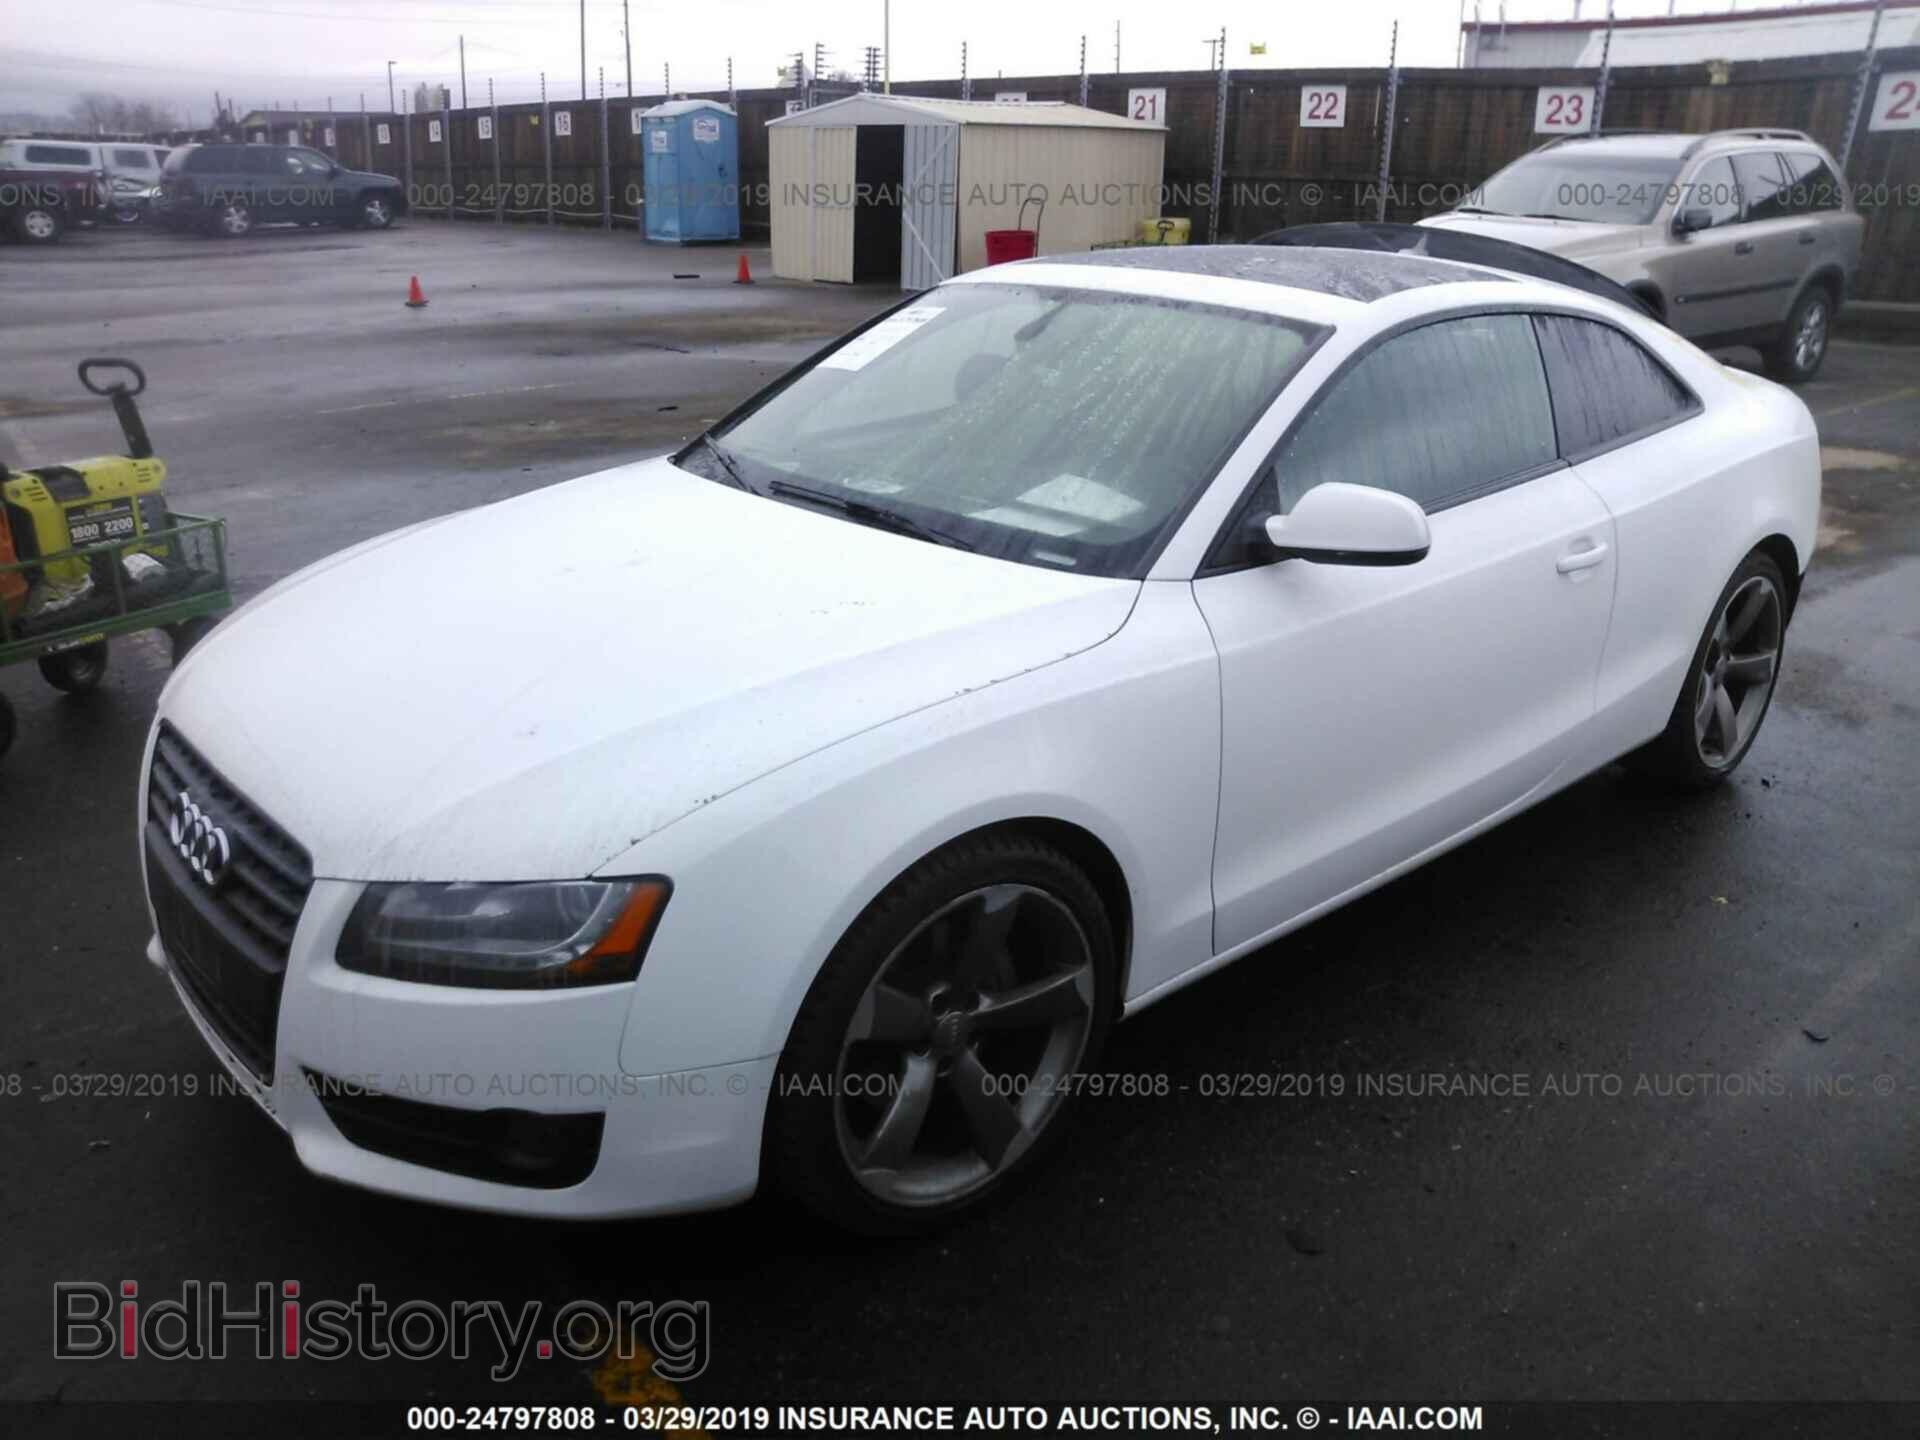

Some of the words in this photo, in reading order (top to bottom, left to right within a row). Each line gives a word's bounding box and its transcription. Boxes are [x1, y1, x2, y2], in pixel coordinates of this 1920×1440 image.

[1134, 95, 1157, 120] 21
[1308, 92, 1339, 120] 22
[1544, 95, 1584, 125] 23
[1886, 81, 1920, 120] 2
[104, 517, 133, 533] 2200
